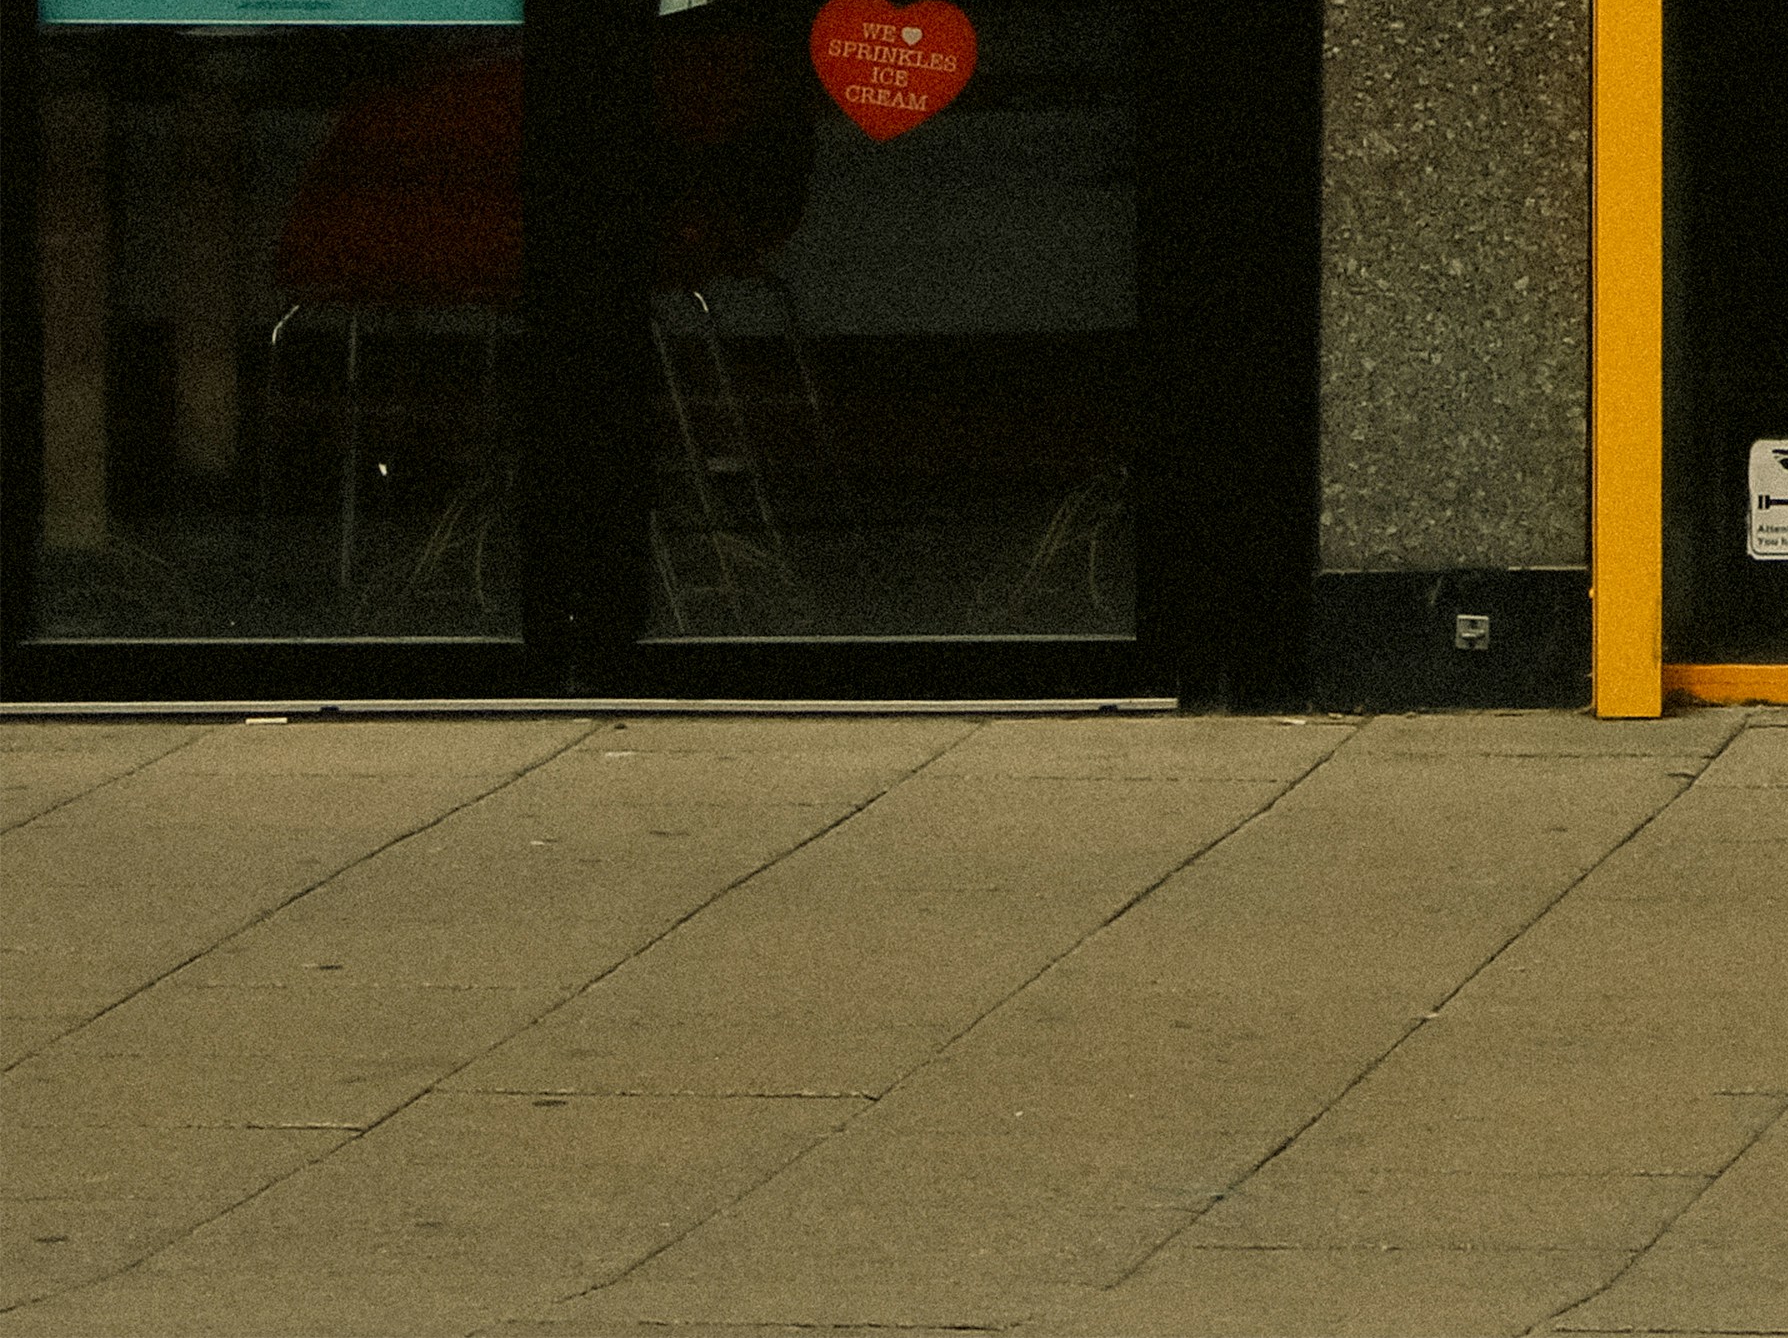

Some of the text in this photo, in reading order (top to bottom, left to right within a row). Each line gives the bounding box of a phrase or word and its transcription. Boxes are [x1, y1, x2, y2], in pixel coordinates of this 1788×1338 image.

[862, 22, 898, 43] WE
[827, 39, 958, 73] SPRINKLES
[870, 66, 910, 88] ICE
[844, 85, 930, 112] CREAM
[1757, 537, 1778, 547] You
